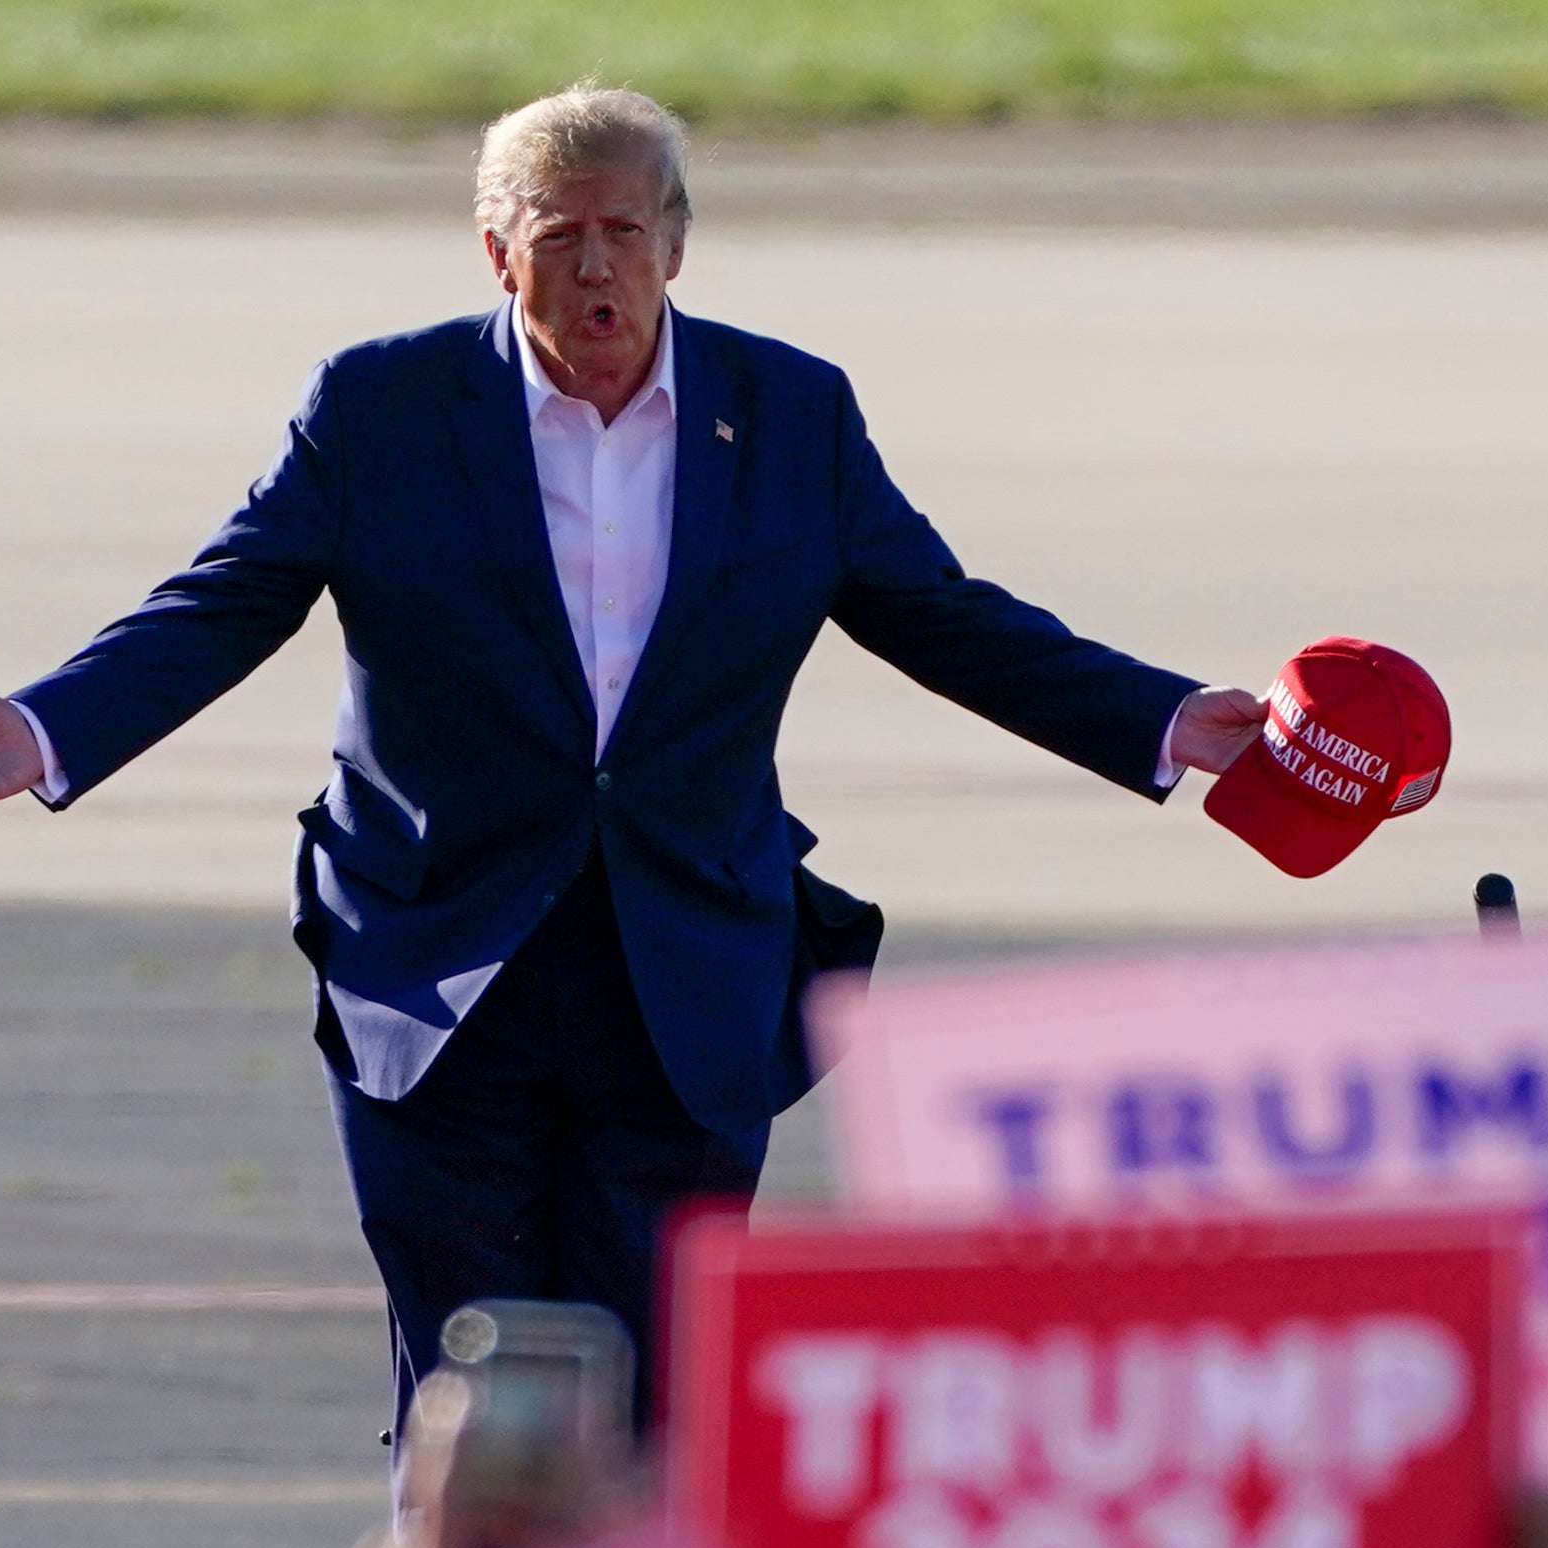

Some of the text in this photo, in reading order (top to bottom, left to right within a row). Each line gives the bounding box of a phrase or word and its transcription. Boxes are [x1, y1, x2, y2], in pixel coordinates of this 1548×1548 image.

[1263, 718, 1368, 806] GREAT AGAIN
[1300, 721, 1390, 784] AMERICA
[757, 1316, 1471, 1515] TRUMP
